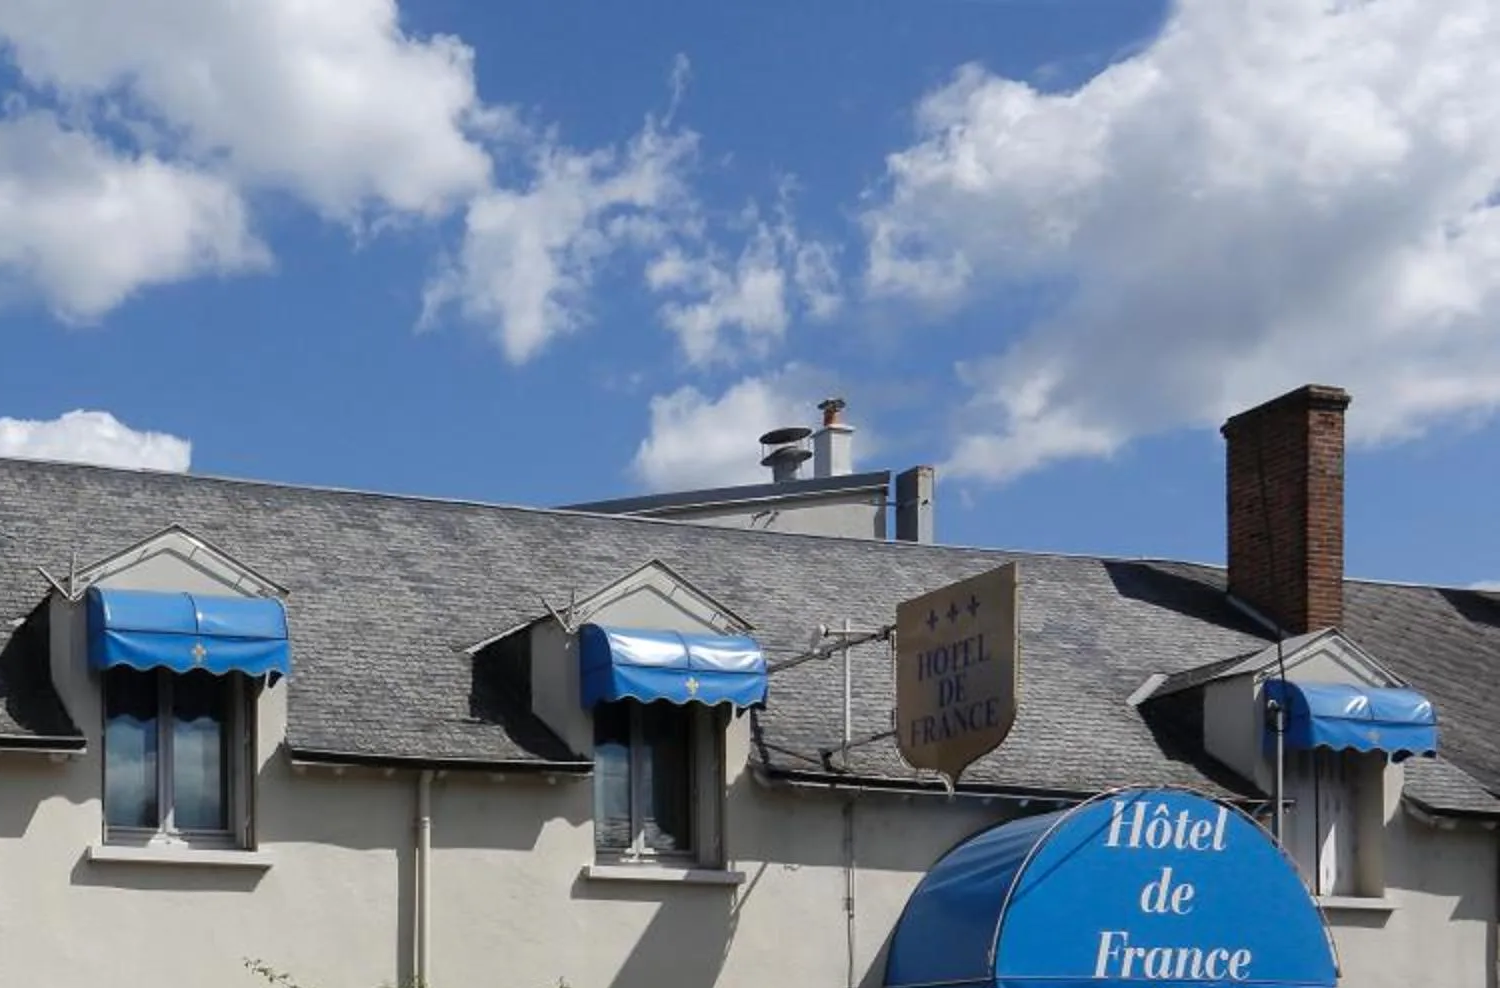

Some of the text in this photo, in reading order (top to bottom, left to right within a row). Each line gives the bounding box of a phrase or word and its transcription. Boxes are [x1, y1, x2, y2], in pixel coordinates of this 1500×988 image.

[917, 633, 991, 682] HOTEL
[939, 674, 966, 707] DE
[910, 698, 999, 748] FRANCE
[1104, 799, 1228, 850] Hôtel
[1140, 866, 1195, 915] de
[1092, 931, 1252, 981] France
